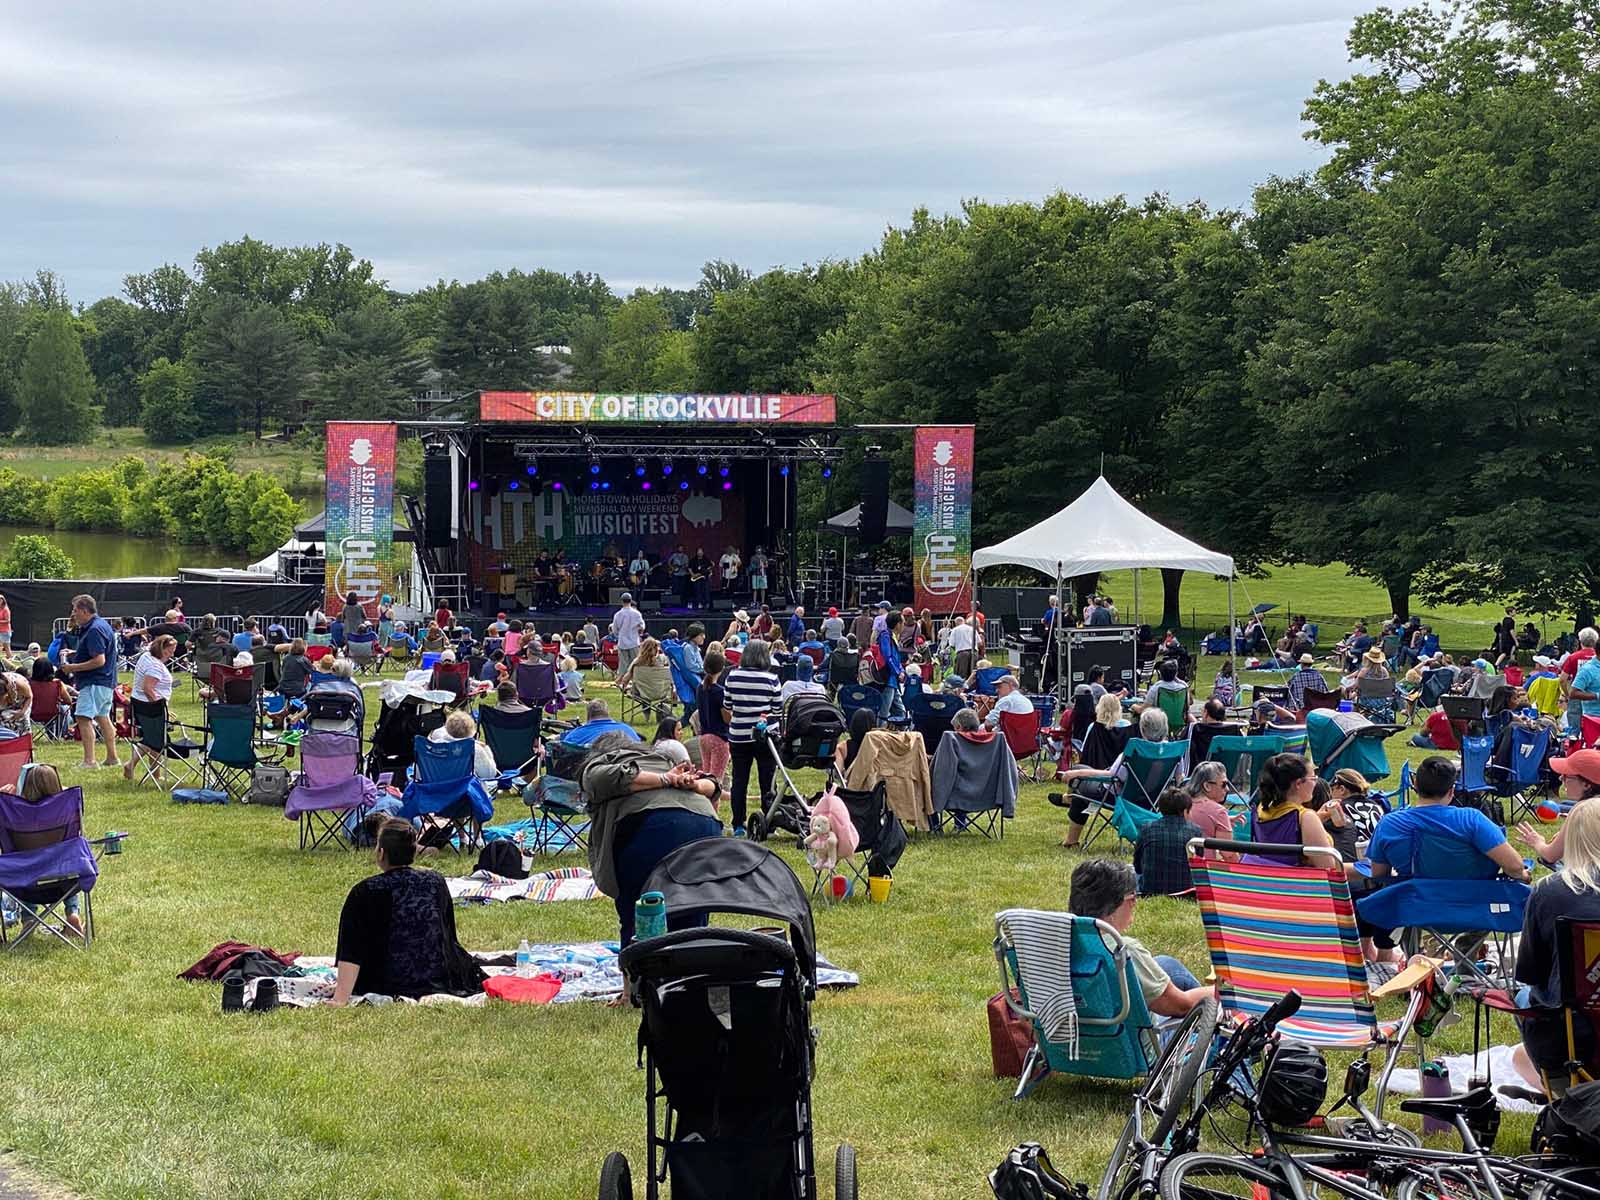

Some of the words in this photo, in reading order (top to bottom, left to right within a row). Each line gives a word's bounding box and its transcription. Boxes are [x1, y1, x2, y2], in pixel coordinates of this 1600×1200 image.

[535, 395, 597, 418] CITY
[602, 395, 639, 418] OF
[643, 396, 782, 419] ROCKVILLE
[361, 466, 376, 492] FEST
[943, 466, 956, 491] FEST
[574, 495, 629, 504] HOMETOWN
[632, 495, 679, 504] HOLIDAYS
[574, 504, 618, 513] MEMORIAL
[620, 504, 637, 513] DAY
[638, 504, 679, 513] WEEKEND
[943, 495, 955, 529] MUSIC
[361, 496, 375, 534] MUSIC
[473, 492, 564, 550] HTH
[574, 514, 633, 536] MUSIC
[639, 514, 680, 534] FEST
[346, 540, 382, 597] HTH
[930, 535, 961, 589] HTH
